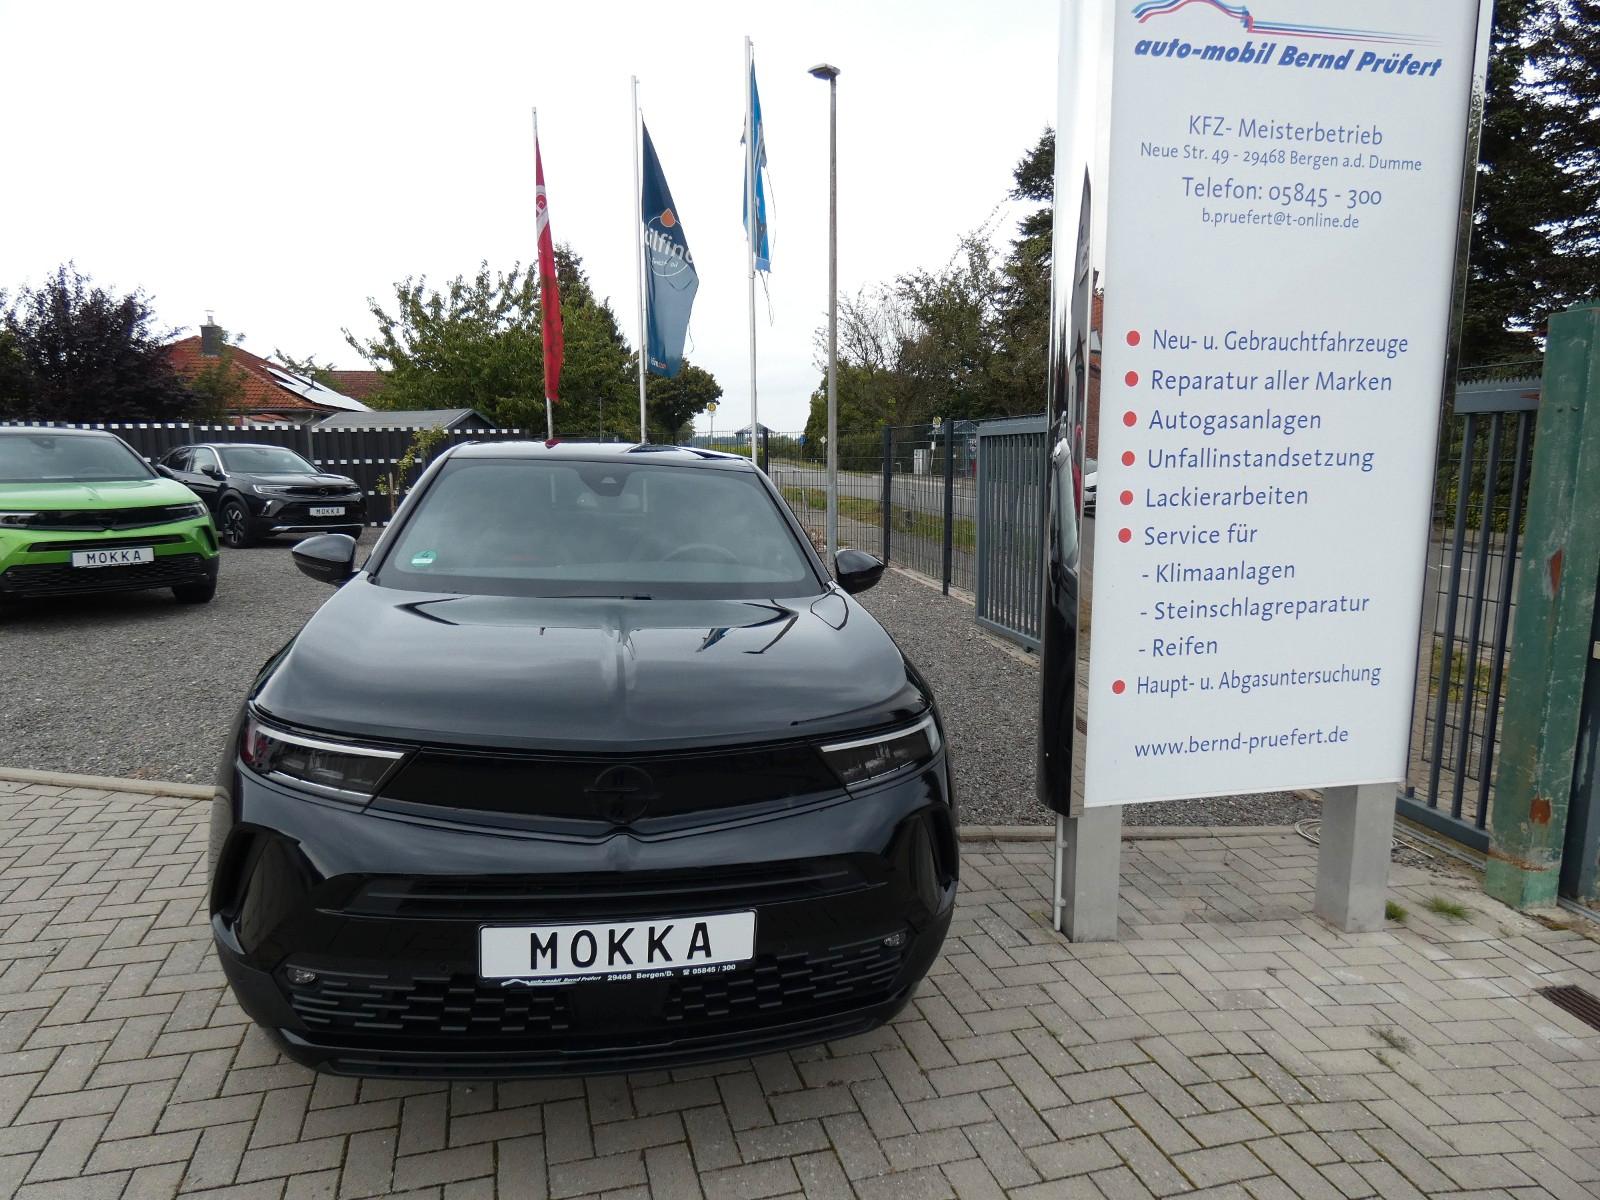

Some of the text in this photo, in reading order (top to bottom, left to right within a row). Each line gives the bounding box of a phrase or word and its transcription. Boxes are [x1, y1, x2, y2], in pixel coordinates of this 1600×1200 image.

[1134, 38, 1443, 77] auto-mobil Bernd Prüfert
[1189, 114, 1383, 146] KFZ- Meisterbetrieb
[1140, 141, 1179, 158] Neue
[1183, 144, 1208, 160] Str.
[1211, 149, 1230, 165] 49
[1243, 148, 1286, 167] 29468
[1290, 150, 1339, 171] Bergen
[1342, 153, 1365, 168] a.d.
[1368, 155, 1422, 172] Dumme
[1181, 176, 1263, 201] Telefon:
[1268, 182, 1328, 208] 05845
[1346, 189, 1382, 210] 300
[1202, 209, 1360, 229] b.pruefert@t-online.de
[1153, 329, 1408, 359] Neu- u. Gebrauchtfahrzeuge
[1151, 369, 1392, 397] Reparatur aller Marken
[1148, 408, 1321, 436] Autogasanlagen
[1148, 446, 1375, 473] Unfallinstandsetzung
[1146, 485, 1308, 508] Lackierarbeiten
[1144, 522, 1258, 546] Service für
[86, 550, 142, 565] MOKKA
[1156, 559, 1295, 586] Klimaanlagen
[1154, 595, 1370, 622] Steinschlagreparatur
[1152, 635, 1218, 657] Reifen
[1137, 663, 1382, 699] Haupt- u. Abgasuntersuchung
[1134, 725, 1349, 757] www.bernd-pruefert.de
[529, 921, 712, 970] MOKKA
[722, 964, 736, 972] 300
